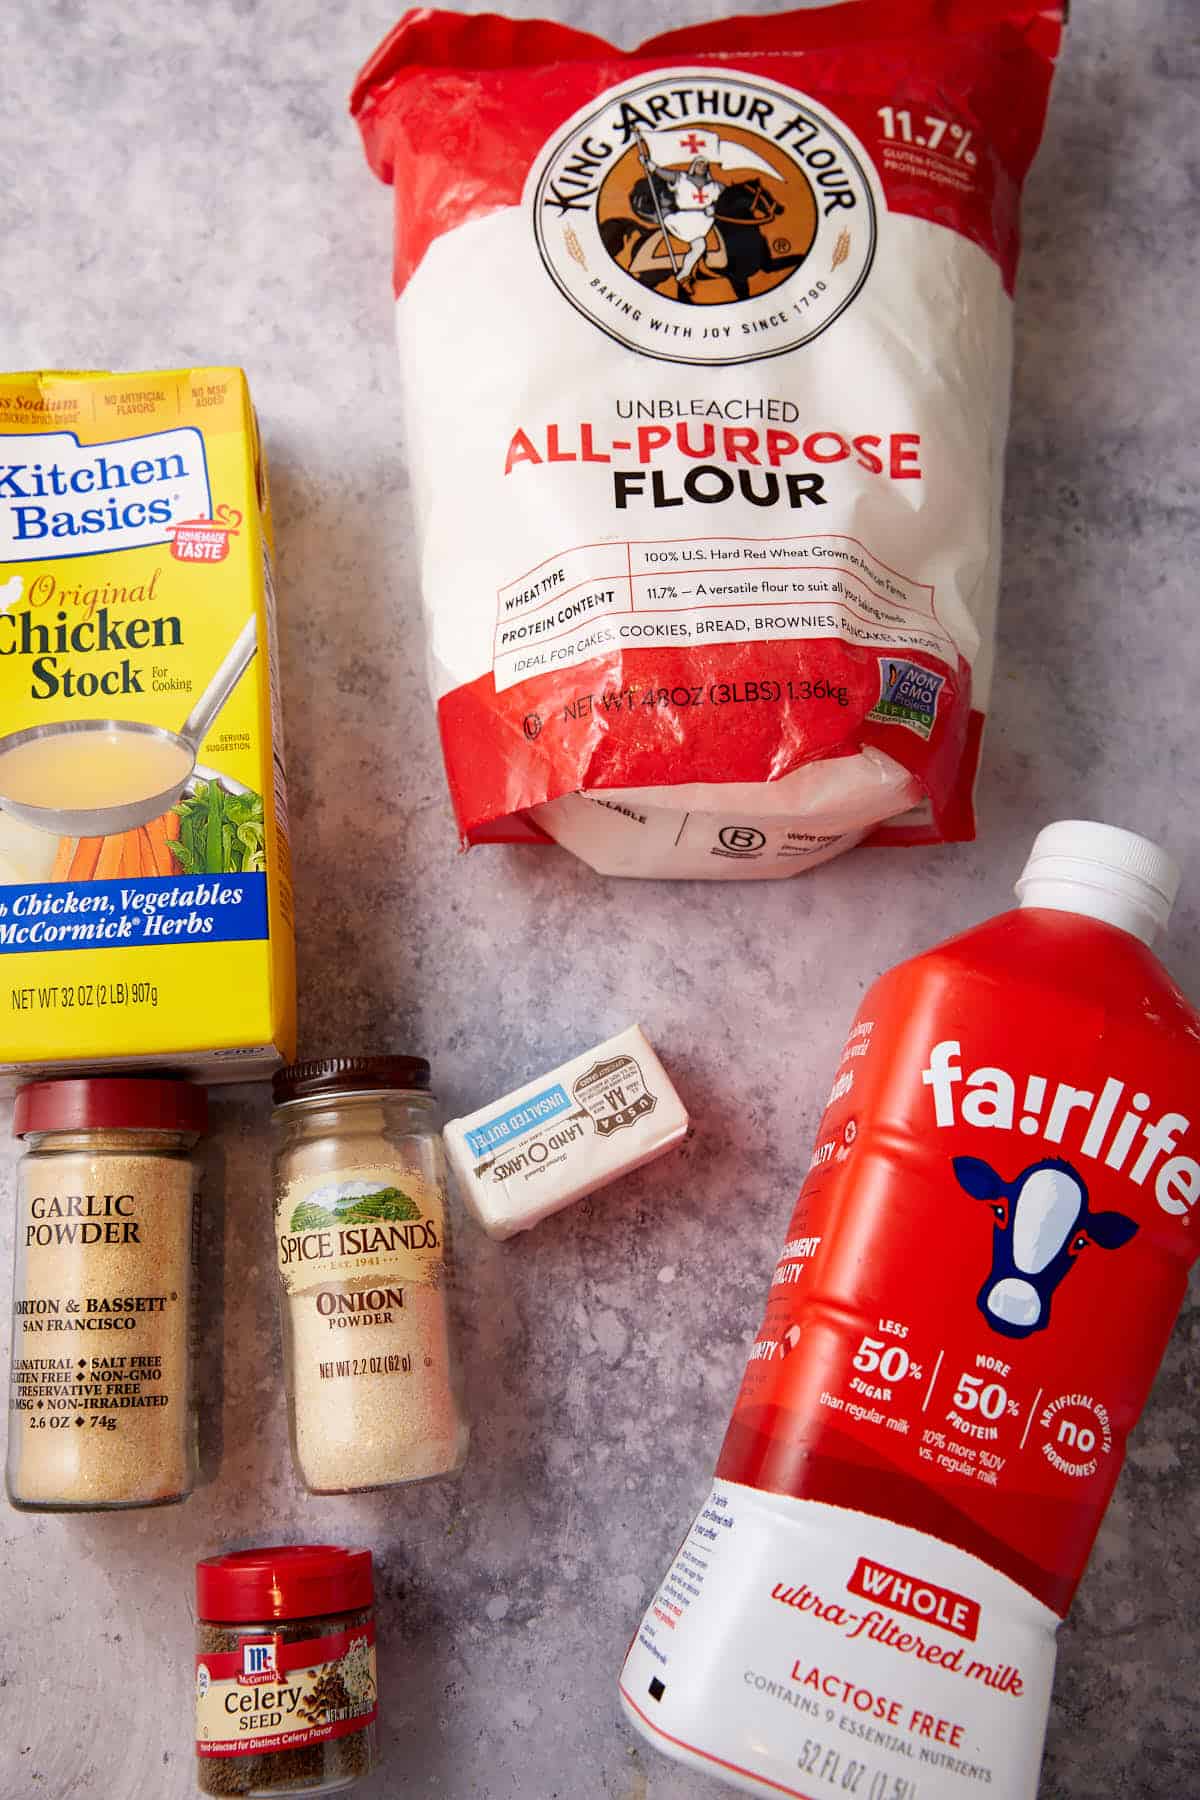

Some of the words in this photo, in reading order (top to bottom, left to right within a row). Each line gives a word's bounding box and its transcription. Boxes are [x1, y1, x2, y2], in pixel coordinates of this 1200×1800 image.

[877, 105, 977, 166] 11.7%
[544, 137, 614, 219] KING
[612, 88, 775, 144] ARTHUR
[773, 117, 858, 218] FLOUR
[589, 278, 642, 323] BAKING
[649, 317, 693, 339] WITH
[702, 326, 732, 341] JOY
[741, 311, 790, 336] SINCE
[792, 280, 829, 316] 1790
[615, 398, 801, 424] UNBLEACHED
[504, 422, 923, 481] ALL-PURPOSE
[0, 453, 190, 499] Kitchen
[613, 464, 829, 510] FLOUR
[10, 496, 173, 541] Basics
[176, 542, 223, 559] TASTE
[644, 551, 680, 563] 100%
[682, 550, 707, 561] U.S.
[711, 548, 740, 560] Hard
[744, 548, 767, 559] Red
[770, 548, 809, 559] Wheat
[812, 546, 850, 560] Grown
[28, 567, 162, 620] Original
[504, 584, 543, 611] WHEAT
[541, 568, 566, 592] TYPE
[646, 586, 678, 600] 11.7%
[696, 583, 708, 596] A
[709, 581, 759, 596] versatile
[762, 581, 789, 593] flour
[793, 582, 805, 592] to
[808, 581, 829, 592] suit
[832, 581, 843, 593] all
[0, 607, 185, 656] Chicken
[501, 615, 556, 645] PROTEIN
[557, 591, 615, 624] CONTENT
[513, 655, 548, 673] IDEAL
[550, 646, 575, 661] FOR
[577, 631, 616, 653] CAKES,
[619, 624, 692, 638] COOKIES,
[696, 619, 751, 634] BREAD,
[754, 615, 839, 631] BROWNIES,
[31, 656, 144, 700] Stock
[151, 678, 193, 695] Cooking
[152, 666, 168, 679] For
[906, 669, 937, 692] NON
[563, 694, 595, 722] NET
[600, 690, 637, 713] WT
[709, 681, 782, 705] (3LBS)
[786, 679, 849, 706] 1.36kg
[899, 681, 932, 704] GMO
[205, 742, 251, 753] SUGGESTION
[12, 891, 115, 917] Chicken,
[120, 883, 243, 914] Vegetables
[0, 917, 132, 945] McCormick
[143, 915, 214, 937] Herbs
[11, 988, 36, 1010] NET
[38, 987, 59, 1008] WT
[61, 987, 74, 1007] 32
[78, 986, 94, 1006] OZ
[96, 985, 107, 1007] (2
[109, 983, 129, 1005] LB)
[132, 982, 158, 1006] 907g
[511, 1092, 565, 1130] UNSALTED
[603, 1086, 628, 1112] AA
[548, 1123, 585, 1151] LAND
[528, 1142, 549, 1163] O
[494, 1153, 530, 1183] LAKES
[31, 1194, 135, 1220] GARLIC
[25, 1221, 142, 1247] POWDER
[280, 1232, 332, 1265] SPICE
[339, 1219, 438, 1257] ISLANDS
[15, 1299, 60, 1315] ORTON
[65, 1299, 81, 1314] &
[86, 1296, 168, 1313] BASSETT
[316, 1287, 405, 1317] ONION
[23, 1320, 43, 1333] SAN
[47, 1317, 137, 1332] FRANCISCO
[328, 1311, 394, 1330] POWDER
[879, 1318, 909, 1339] LESS
[90, 1357, 126, 1370] SALT
[130, 1355, 162, 1368] FREE
[319, 1362, 335, 1379] NET
[336, 1359, 351, 1378] WT
[353, 1357, 367, 1376] 2.2
[370, 1356, 382, 1374] OZ
[852, 1336, 923, 1383] 50%
[976, 1353, 1012, 1378] MORE
[17, 1384, 102, 1398] PRESERVATIVE
[106, 1383, 142, 1396] FREE
[41, 1371, 72, 1383] FREE
[90, 1368, 163, 1382] NON-GMO
[849, 1376, 893, 1402] SUGAR
[15, 1398, 34, 1410] MSG
[47, 1395, 169, 1410] NON-IRRADIATED
[952, 1372, 1021, 1421] 50%
[1040, 1393, 1093, 1429] ARTIFICIAL
[30, 1416, 46, 1429] 2.6
[50, 1416, 70, 1429] OZ
[90, 1415, 118, 1431] 74g
[819, 1391, 844, 1410] than
[844, 1400, 886, 1425] regular
[886, 1416, 911, 1435] milk
[945, 1410, 999, 1441] PROTEIN
[922, 1429, 946, 1448] 10%
[947, 1441, 978, 1460] more
[1057, 1419, 1096, 1453] no
[919, 1447, 936, 1463] vs.
[936, 1452, 977, 1477] regular
[977, 1467, 1001, 1487] milk
[862, 1565, 970, 1632] WHOLE
[770, 1581, 964, 1673] ultra-filtered
[964, 1662, 1025, 1698] milk
[239, 1669, 283, 1686] McCormick
[224, 1686, 303, 1714] Celery
[791, 1659, 904, 1727] LACTOSE
[908, 1709, 965, 1749] FREE
[239, 1713, 282, 1731] SEED
[281, 1732, 308, 1746] Celery
[308, 1726, 333, 1740] Flavor
[743, 1670, 819, 1718] CONTAINS
[825, 1710, 835, 1724] 9
[838, 1717, 913, 1759] ESSENTIAL
[920, 1747, 993, 1785] NUTRIENTS
[797, 1738, 822, 1775] 52
[820, 1749, 841, 1784] FL
[841, 1760, 867, 1793] OZ
